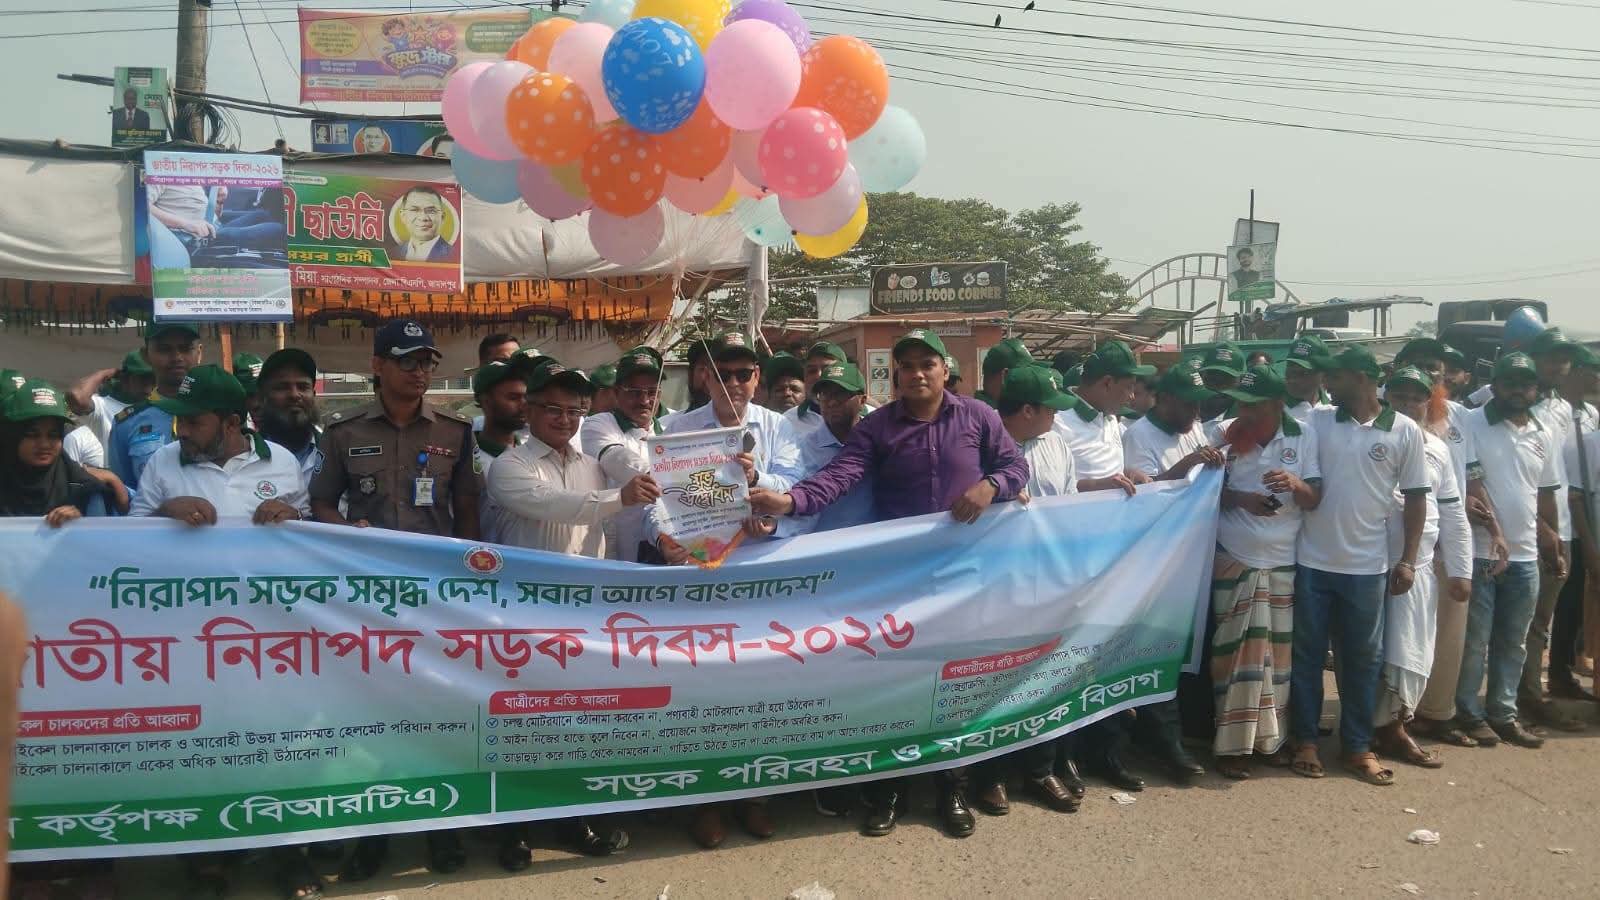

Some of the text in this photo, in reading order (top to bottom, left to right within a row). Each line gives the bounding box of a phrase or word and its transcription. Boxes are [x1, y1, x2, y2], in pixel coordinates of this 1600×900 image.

[301, 191, 385, 243] ছাউনি
[878, 286, 1001, 304] FRIENDS FOOD CORNER
[247, 575, 340, 613] সড়ক
[346, 575, 430, 618] সমৃদ্ধ
[437, 577, 508, 609] দেশ,
[515, 581, 596, 608] সবার
[601, 584, 678, 603] আগে
[17, 611, 915, 688] াতীয় নিরাপদ সড়ক দিবস-২০২৬
[502, 716, 523, 728] চলন্ত
[526, 713, 572, 728] মোটরযানে
[576, 711, 610, 726] ওঠানামা
[614, 711, 645, 723] করবেন
[665, 705, 699, 721] পণ্যবাহী
[702, 704, 745, 720] মোটরযানে
[747, 701, 765, 716] যাত্রী
[767, 701, 784, 713] হয়ে
[787, 697, 815, 711] উঠবেন
[504, 692, 550, 709] যাত্রীদের
[553, 692, 578, 707] প্রতি
[48, 716, 109, 732] চালকদের
[113, 711, 141, 728] প্রতি
[63, 740, 130, 756] চালনাকালে
[137, 739, 172, 753] চালক
[177, 740, 188, 750] ও
[193, 731, 240, 749] আরোহী
[246, 731, 276, 745] উভয়
[281, 726, 334, 744] মানসম্মত
[339, 722, 387, 739] হেলমেট
[390, 719, 433, 734] পরিধান
[502, 735, 528, 746] আইন
[531, 731, 560, 744] নিজের
[564, 732, 585, 745] হাতে
[590, 732, 609, 746] তুলে
[612, 728, 638, 741] নিবেন
[658, 725, 697, 739] প্রয়োজনে
[751, 717, 789, 732] বাহিনীকে
[791, 713, 820, 728] অবহিত
[582, 768, 704, 799] সড়ক
[718, 749, 879, 785] পরিবহন
[890, 743, 922, 763] ও
[932, 700, 1073, 756] মহাসড়ক
[1078, 668, 1164, 713] বিভাগ
[502, 751, 541, 765] তাড়াহুড়া
[545, 750, 564, 762] করে
[567, 746, 588, 761] গাড়ি
[590, 746, 614, 760] থেকে
[617, 745, 650, 758] নামবেন
[669, 740, 701, 755] গাড়িতে
[704, 738, 727, 751] উঠতে
[731, 738, 747, 750] ডান
[750, 737, 760, 747] পা
[762, 735, 778, 747] এবং
[782, 732, 807, 745] নামতে
[809, 731, 825, 743] বাম
[827, 730, 837, 740] পা
[839, 726, 858, 739] আগে
[889, 718, 916, 732] করবেন
[63, 760, 131, 777] চালনাকালে
[137, 759, 175, 773] একের
[179, 753, 218, 769] অধিক
[221, 748, 268, 768] আরোহী
[274, 746, 321, 763] উঠাবেন
[34, 803, 205, 841] কর্তৃপক্ষ
[219, 783, 460, 831] (বিআরটিএ)
